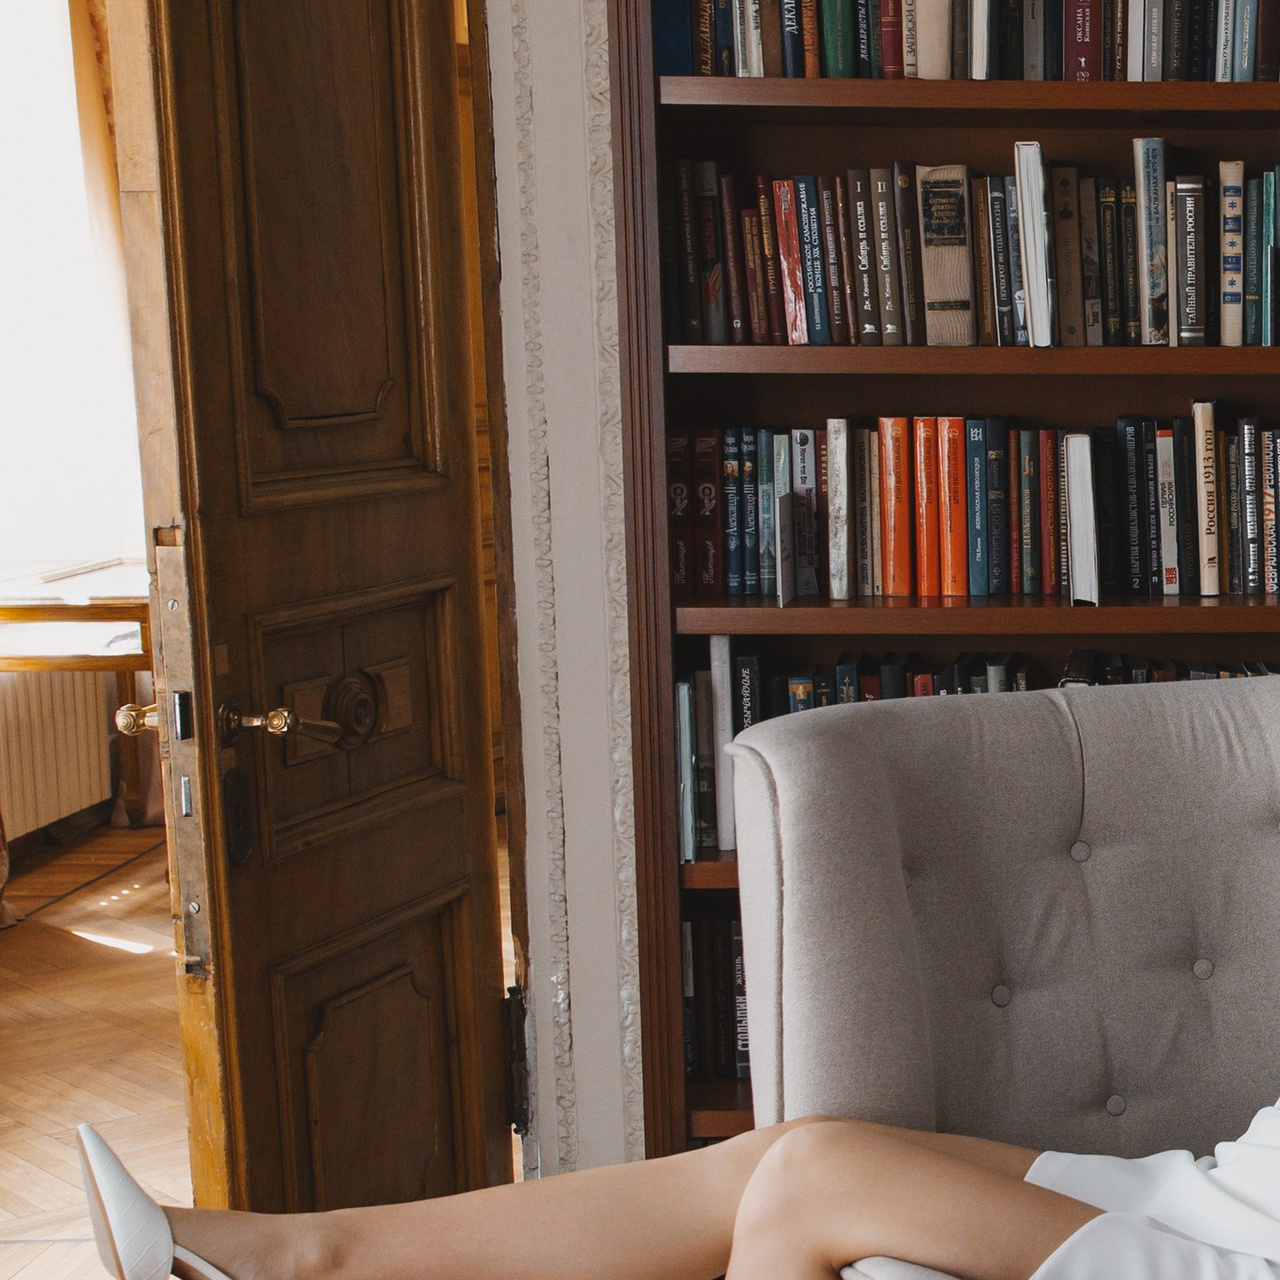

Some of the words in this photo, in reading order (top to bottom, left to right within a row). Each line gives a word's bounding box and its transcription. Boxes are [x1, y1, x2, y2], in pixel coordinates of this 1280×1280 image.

[859, 7, 868, 60] ДЕКАБРИСТЫ
[905, 9, 915, 56] ЗАПИСКИ
[799, 182, 811, 242] САМОДЕРЖАВИЕ
[810, 207, 819, 245] СТОЛЕТИЯ
[856, 201, 865, 231] ссылка
[878, 201, 887, 230] ссылка
[1186, 197, 1194, 232] РОССИИ
[804, 244, 815, 293] РОССИЙСКОЕ
[814, 260, 822, 286] КОНЦЕ
[858, 241, 869, 271] Сибирь
[880, 240, 891, 271] Сибирь
[1186, 233, 1195, 284] ПРАВИТЕЛЬ
[1186, 286, 1196, 325] ТАЙНЫЙ
[1205, 429, 1213, 452] год
[1203, 457, 1214, 486] 1913
[1262, 431, 1274, 491] РЕВОЛЮЦИЯ
[725, 494, 739, 536] Александр
[744, 494, 757, 534] Александр
[1204, 491, 1215, 535] Россия
[1263, 491, 1275, 524] 1917
[991, 503, 1001, 563] КЕРЕНСКИЙ
[861, 563, 869, 584] ДЕЛО
[1129, 546, 1140, 574] ПАРТИЯ
[1265, 524, 1278, 593] ФЕВРАЛЬСКАЯ
